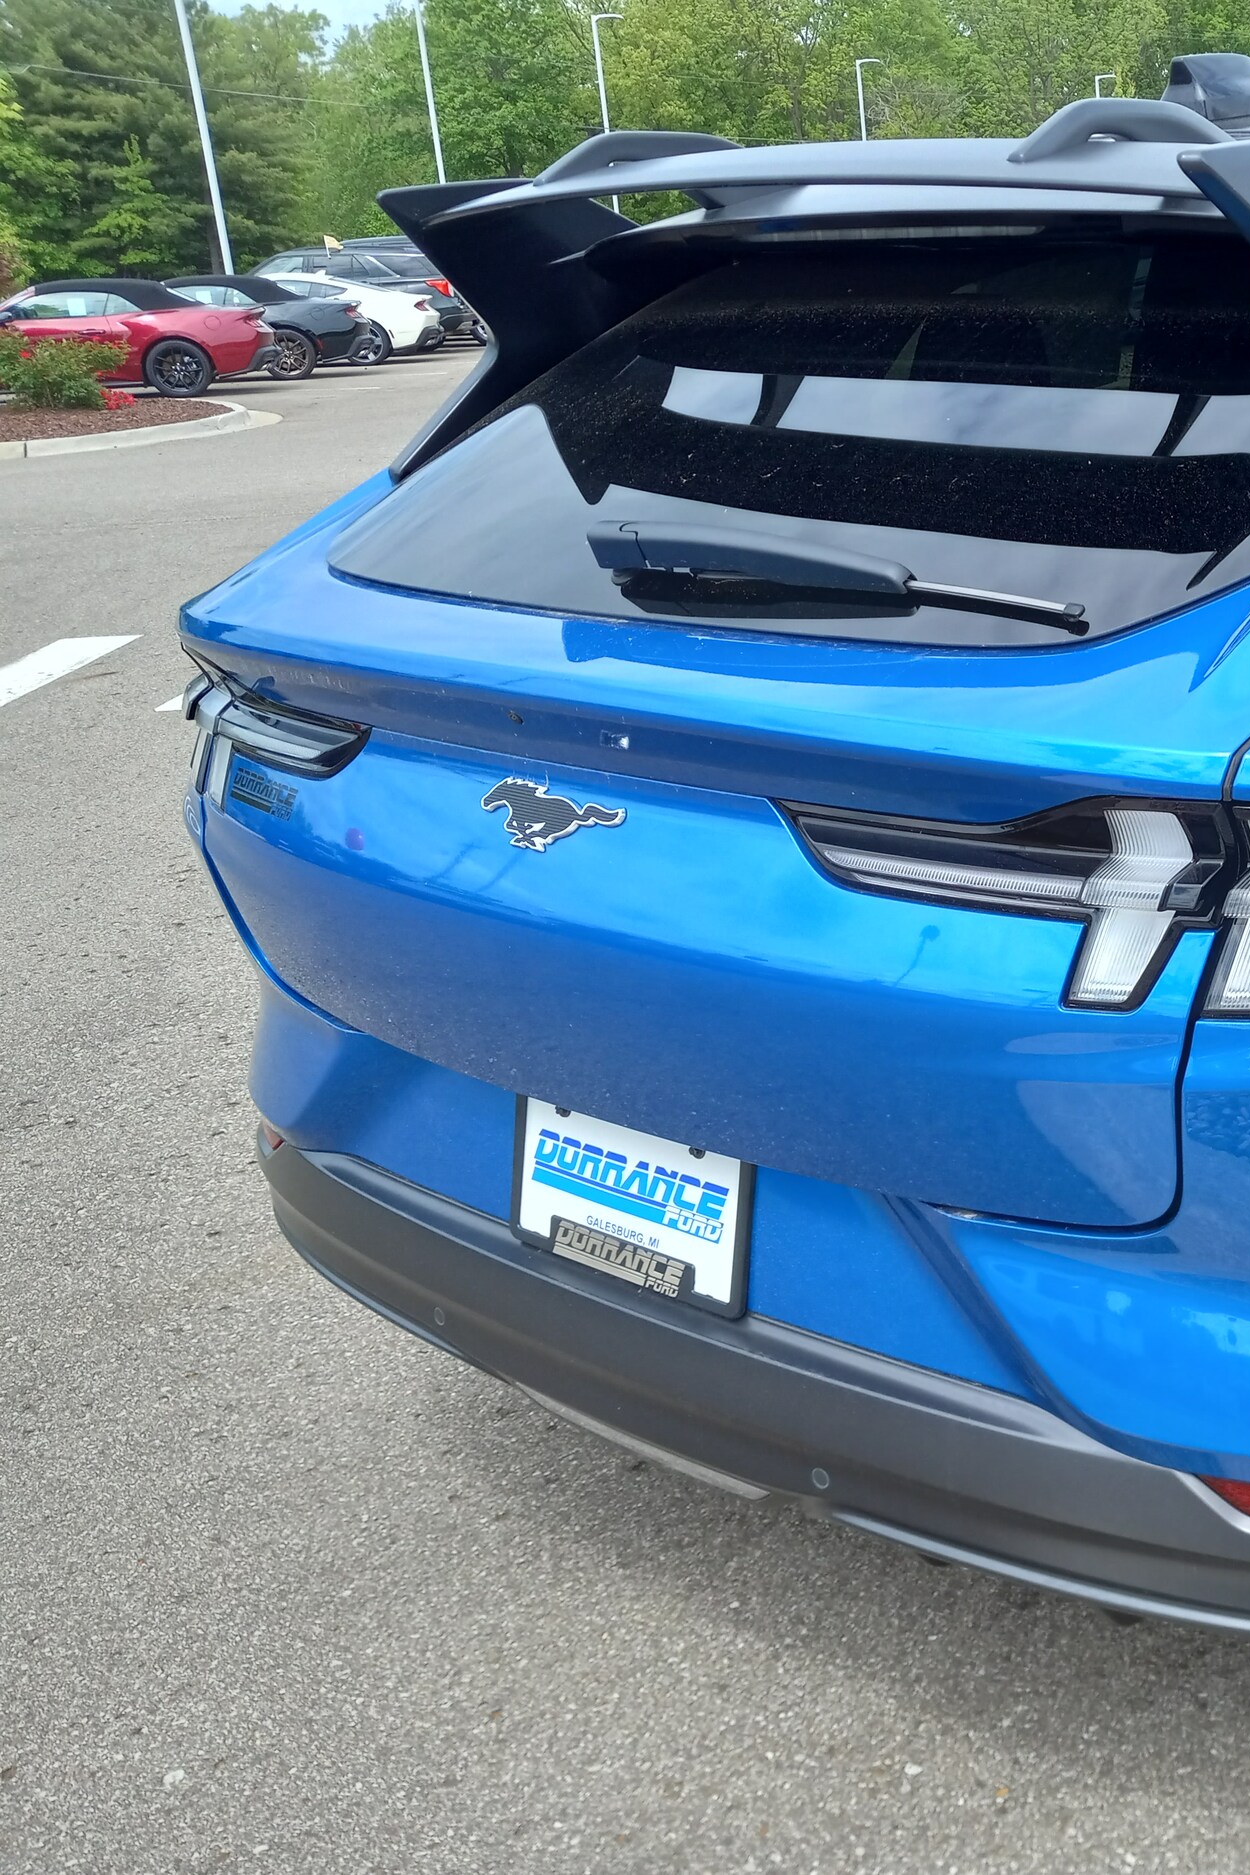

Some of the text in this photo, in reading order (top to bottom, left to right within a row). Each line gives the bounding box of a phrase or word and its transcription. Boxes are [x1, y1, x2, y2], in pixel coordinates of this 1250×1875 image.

[533, 1128, 730, 1220] DORRANCE
[586, 1215, 660, 1249] GALESBURG, MI
[661, 1205, 725, 1242] FORD
[554, 1220, 686, 1286] DORRANCE
[645, 1276, 680, 1299] FORD
